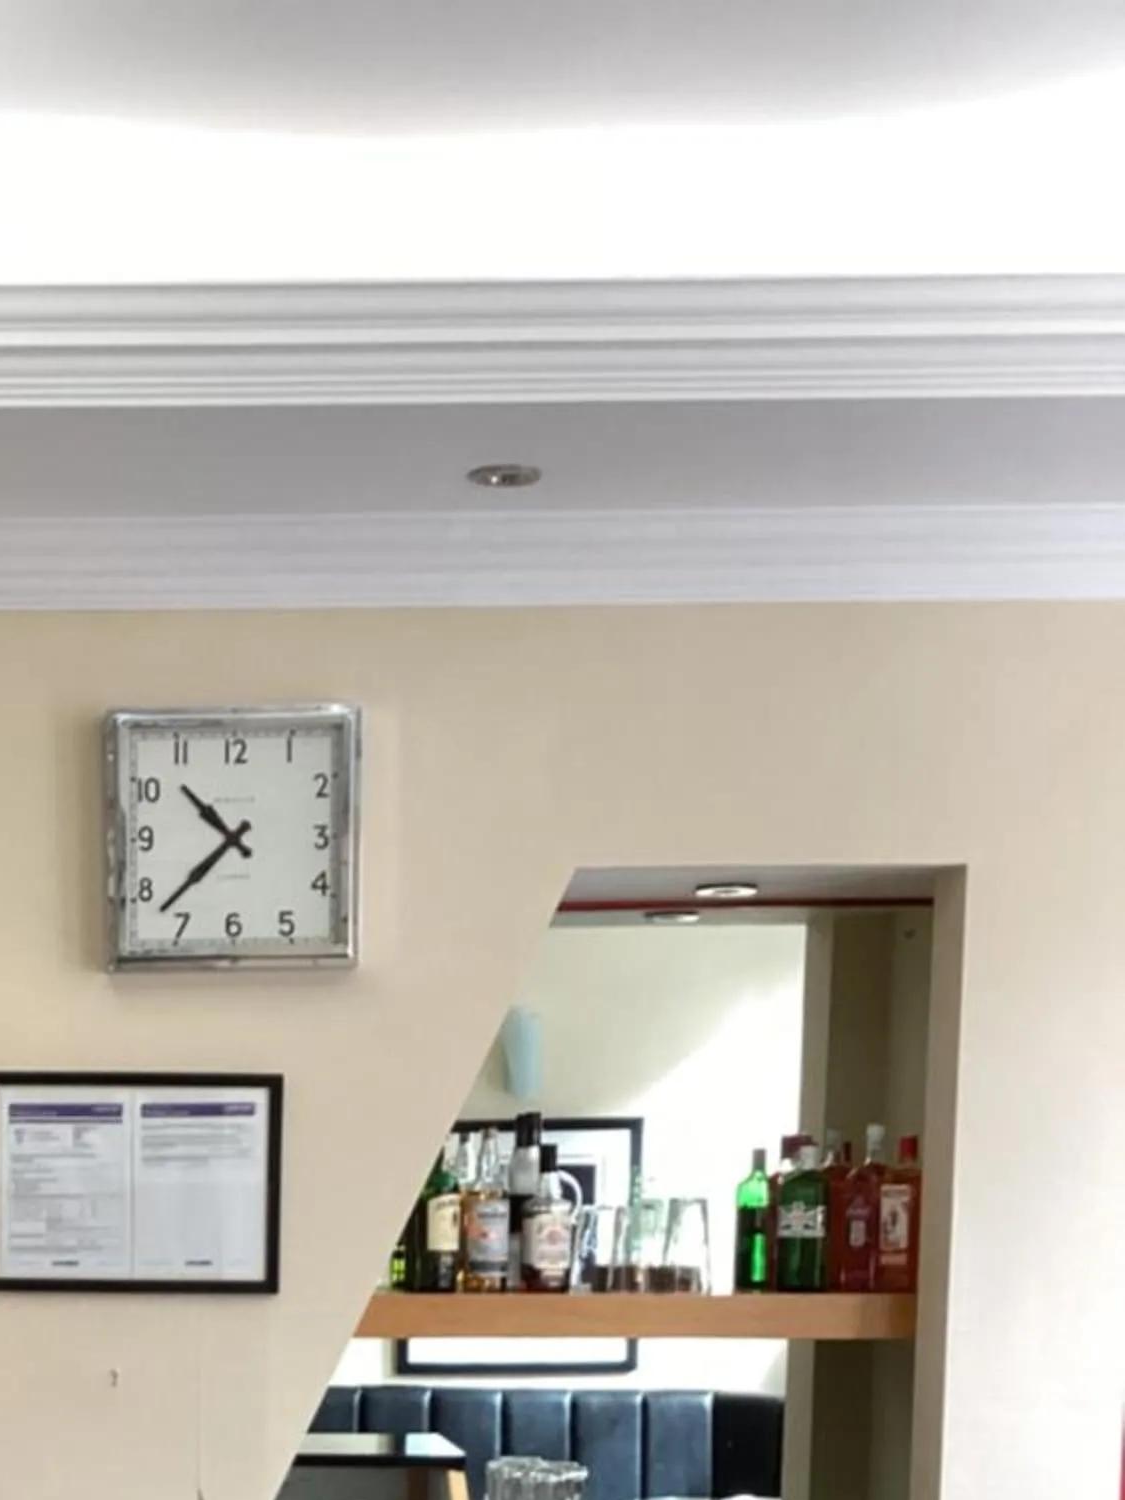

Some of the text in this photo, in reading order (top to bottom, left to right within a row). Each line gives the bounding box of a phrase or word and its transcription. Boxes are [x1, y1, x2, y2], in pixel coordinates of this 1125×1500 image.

[174, 738, 188, 765] 11
[224, 738, 248, 765] 12
[137, 777, 160, 803] 10
[313, 773, 330, 799] 2
[137, 825, 154, 851] 9
[313, 825, 330, 850] 3
[137, 877, 154, 902] 8
[311, 871, 330, 897] 4
[174, 912, 191, 940] 7
[224, 912, 242, 938] 6
[277, 911, 295, 937] 5
